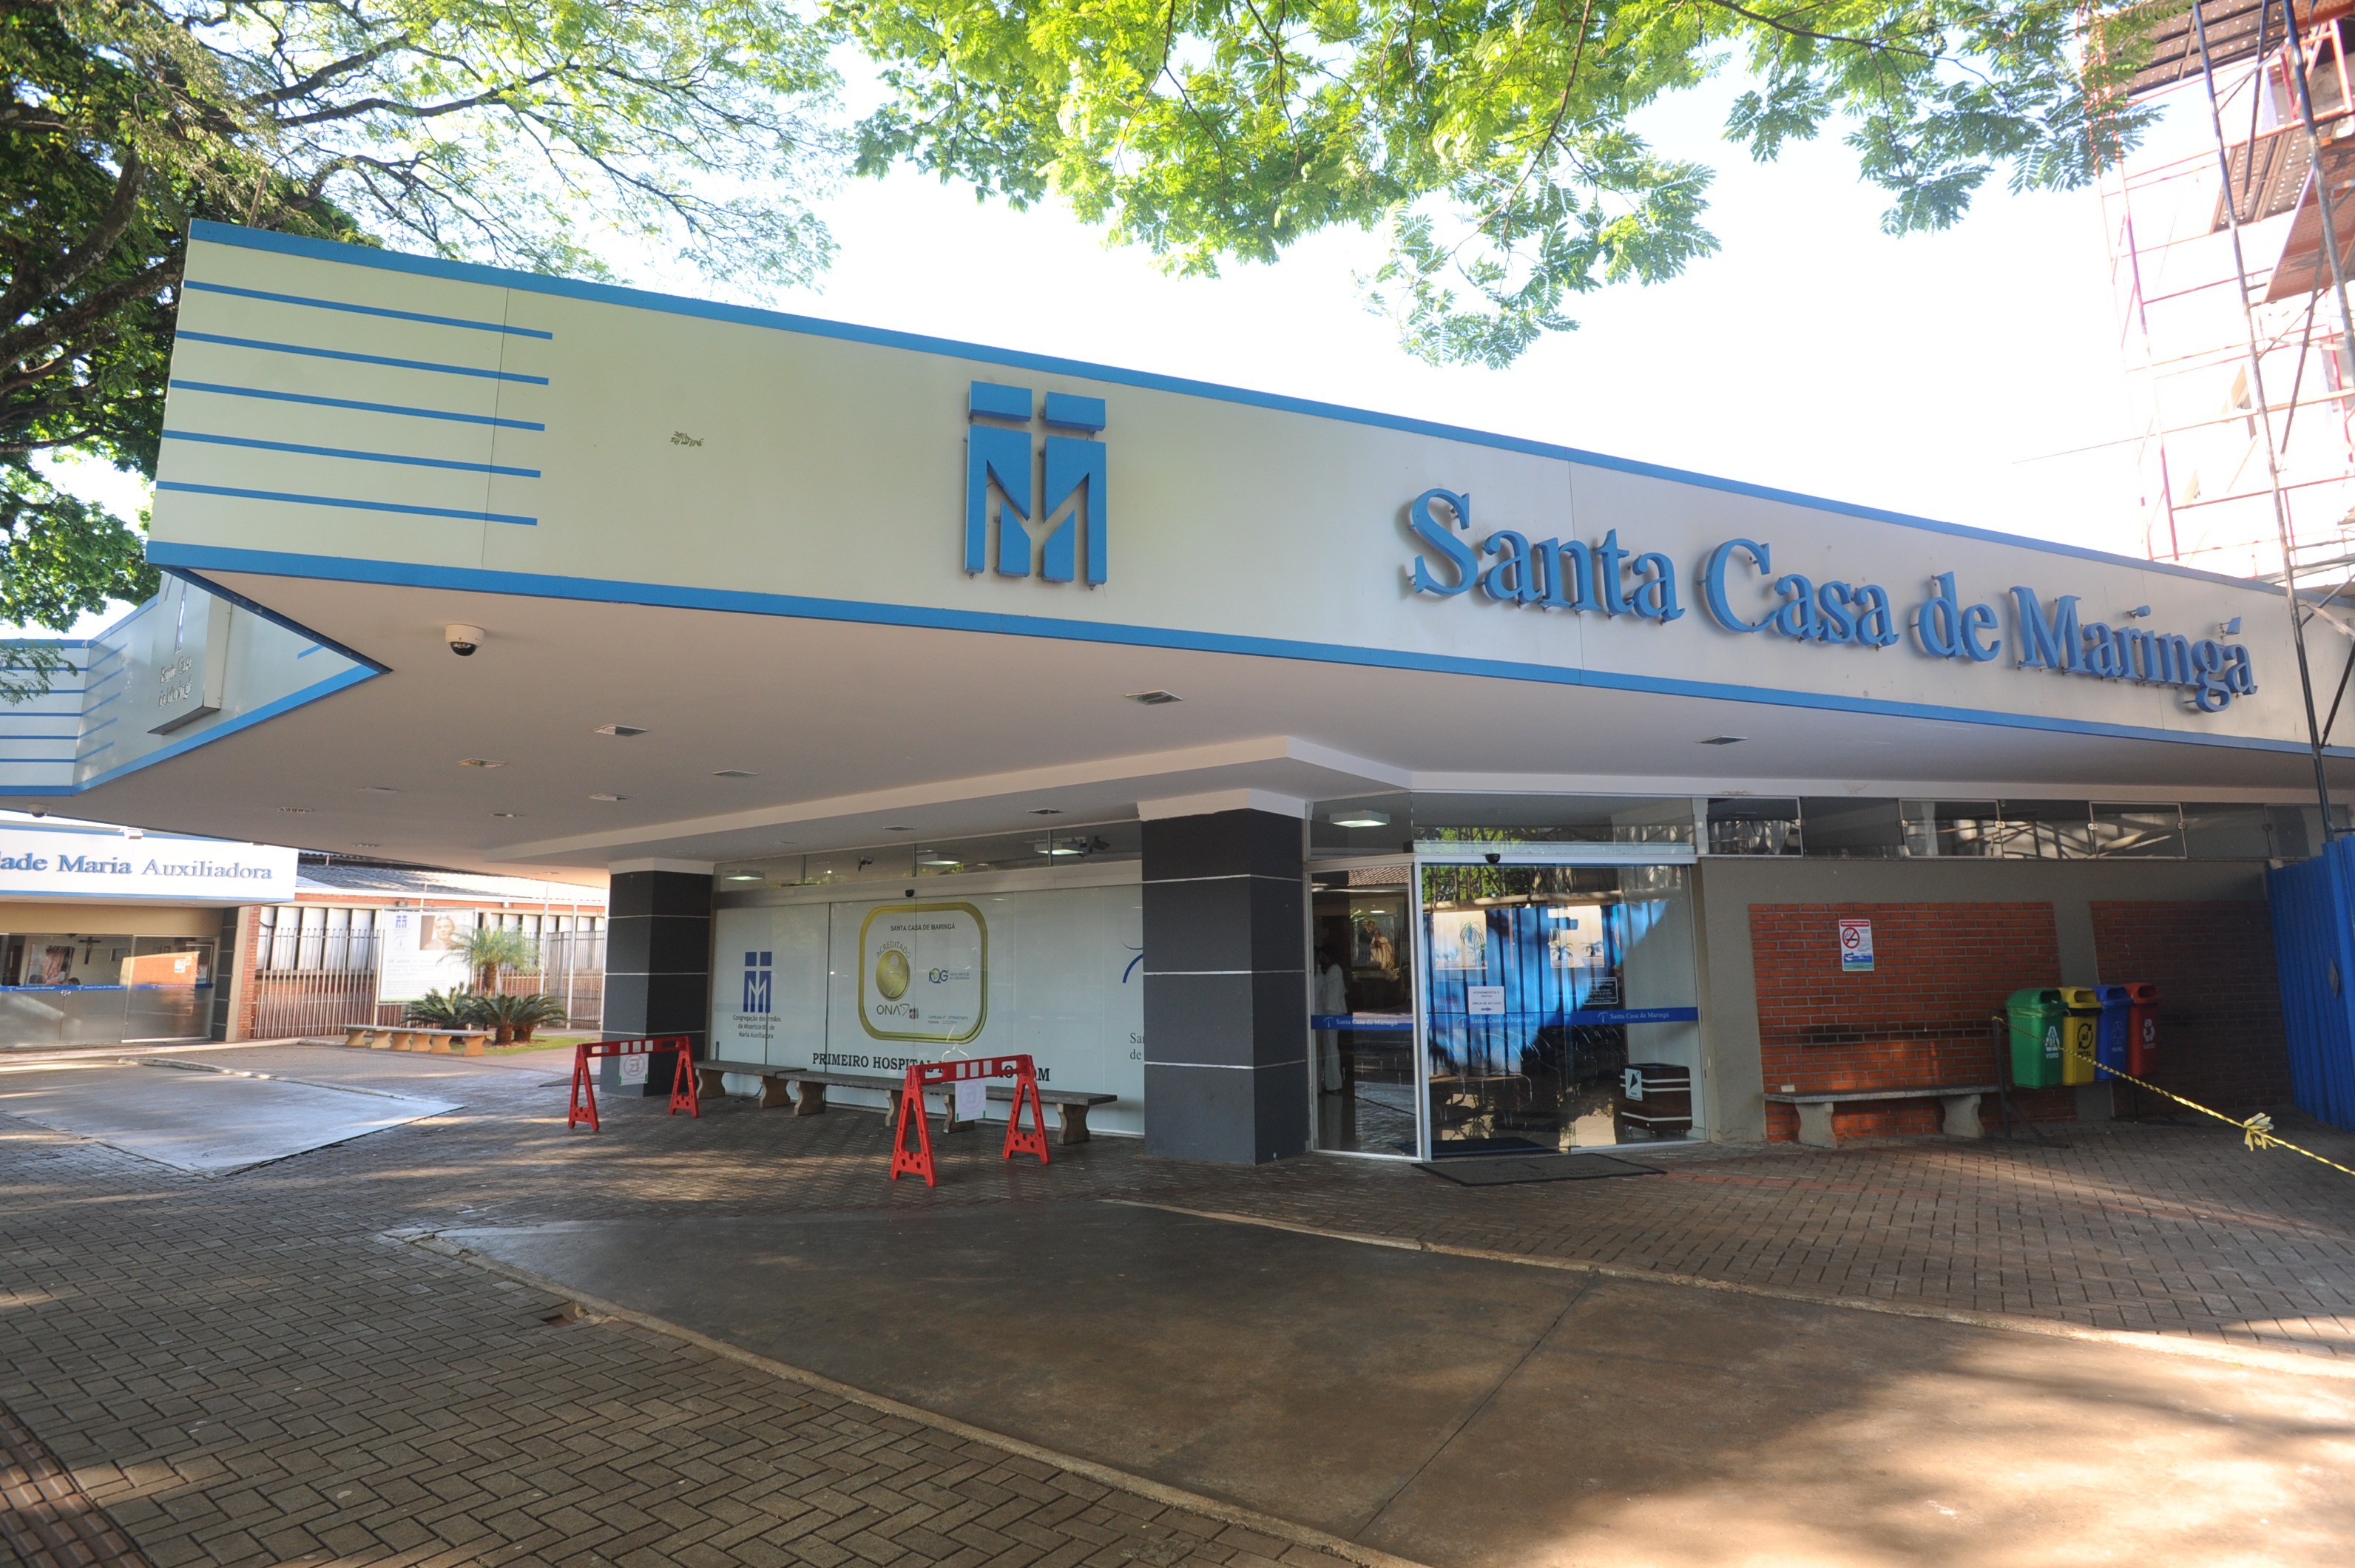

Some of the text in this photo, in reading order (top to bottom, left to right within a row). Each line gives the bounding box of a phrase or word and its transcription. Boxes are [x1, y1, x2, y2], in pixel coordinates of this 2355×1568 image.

[1411, 488, 2258, 713] Santa Casa de Maringá
[0, 853, 273, 879] ade Maria Auxiliadora
[931, 922, 956, 930] MARINGÁ
[876, 941, 911, 959] ACREDITADO
[1647, 1011, 1669, 1019] Maringá
[812, 1052, 869, 1068] PRIMEIRO
[1129, 1048, 1142, 1060] de
